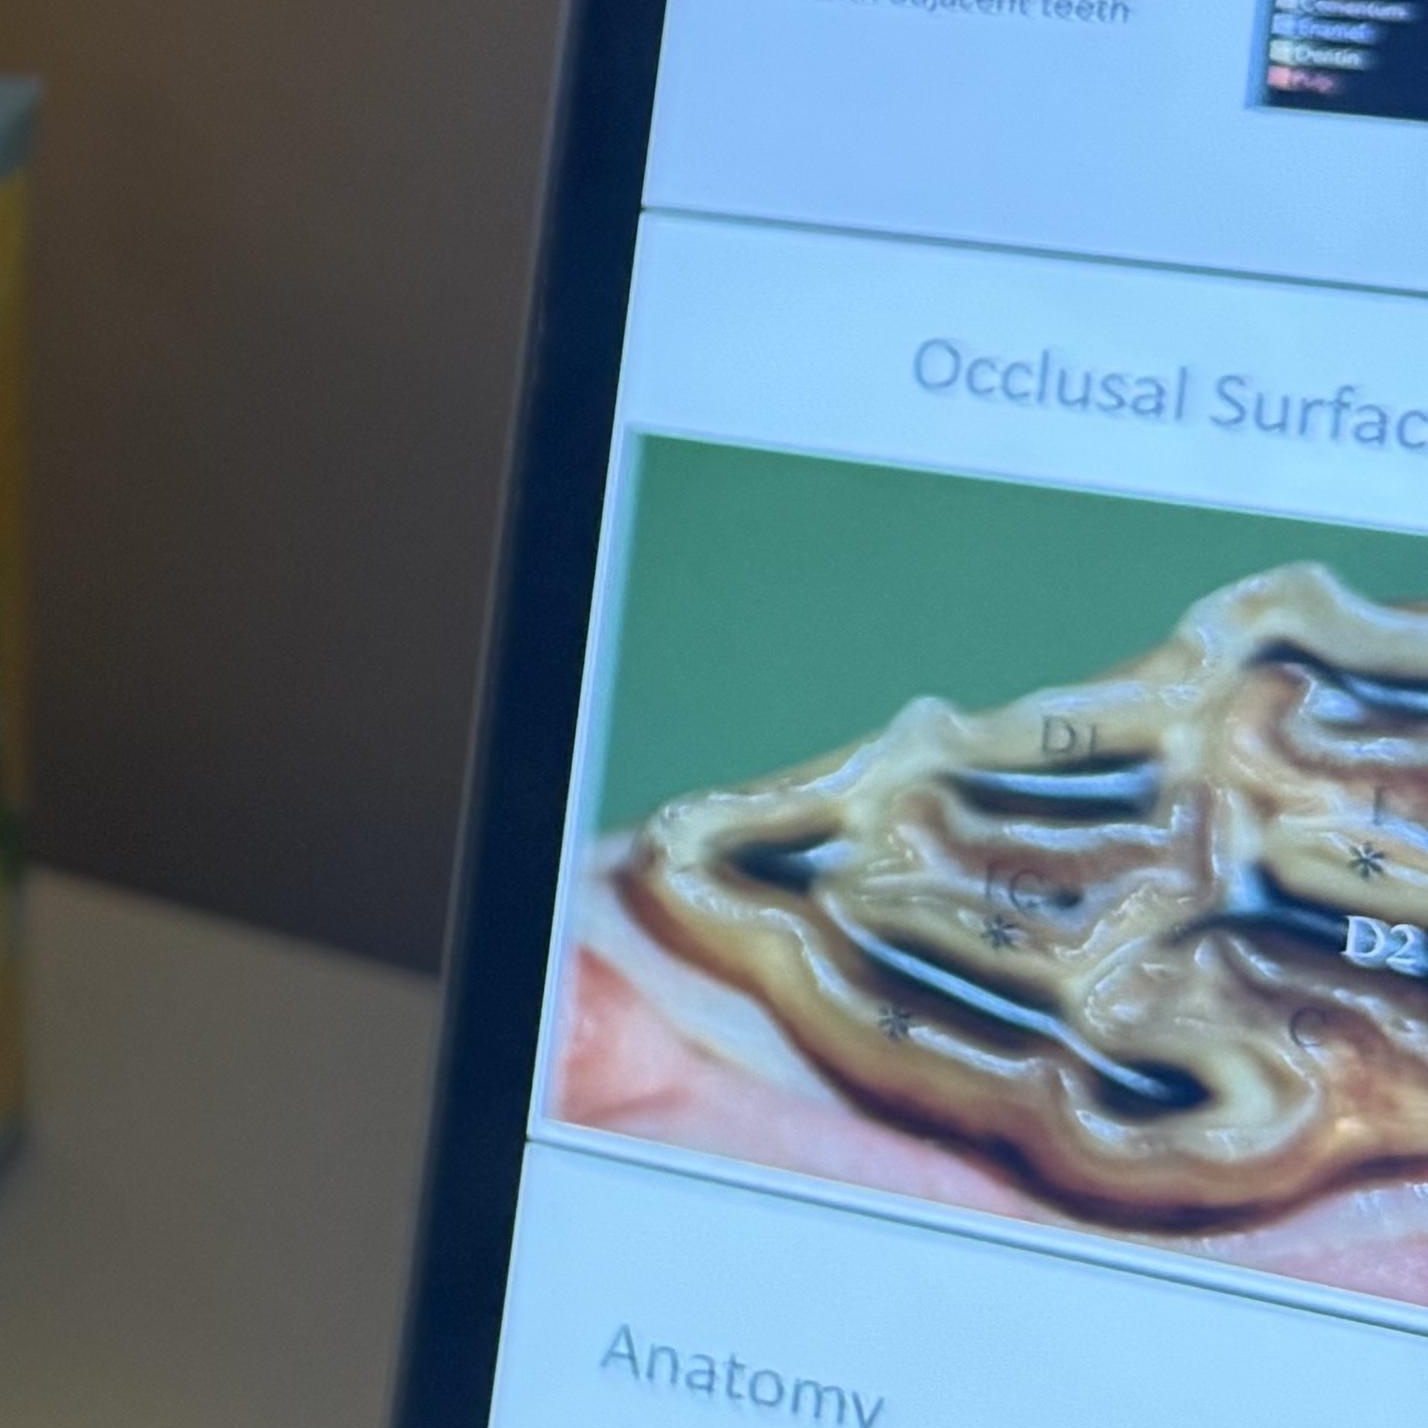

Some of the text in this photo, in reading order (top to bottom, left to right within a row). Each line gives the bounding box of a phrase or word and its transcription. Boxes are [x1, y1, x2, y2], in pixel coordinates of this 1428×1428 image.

[913, 337, 1428, 451] Occlusal Surfac
[1340, 915, 1418, 972] D2
[599, 1322, 886, 1428] Anatomy
